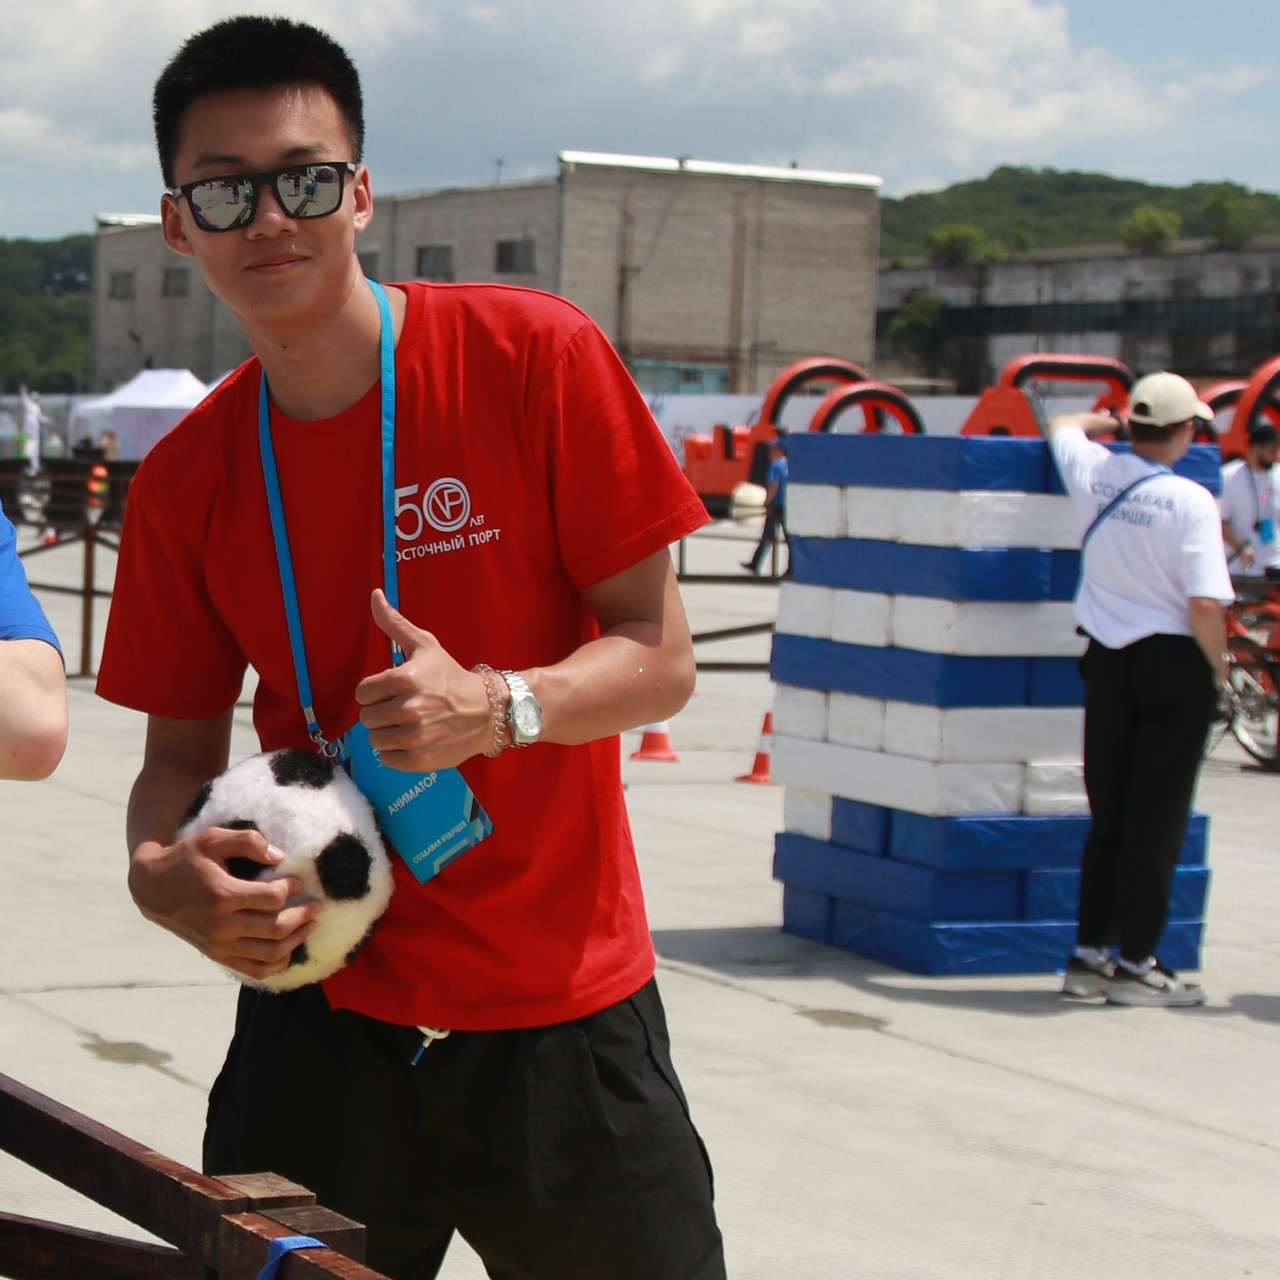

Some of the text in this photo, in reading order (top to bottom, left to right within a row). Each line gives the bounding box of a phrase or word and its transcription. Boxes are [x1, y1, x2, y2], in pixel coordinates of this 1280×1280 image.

[382, 528, 502, 563] ОСТОЧНЫЙ ПОРТ
[388, 772, 438, 816] АНИМАТОР
[412, 838, 441, 864] СОЗДАВАЯ
